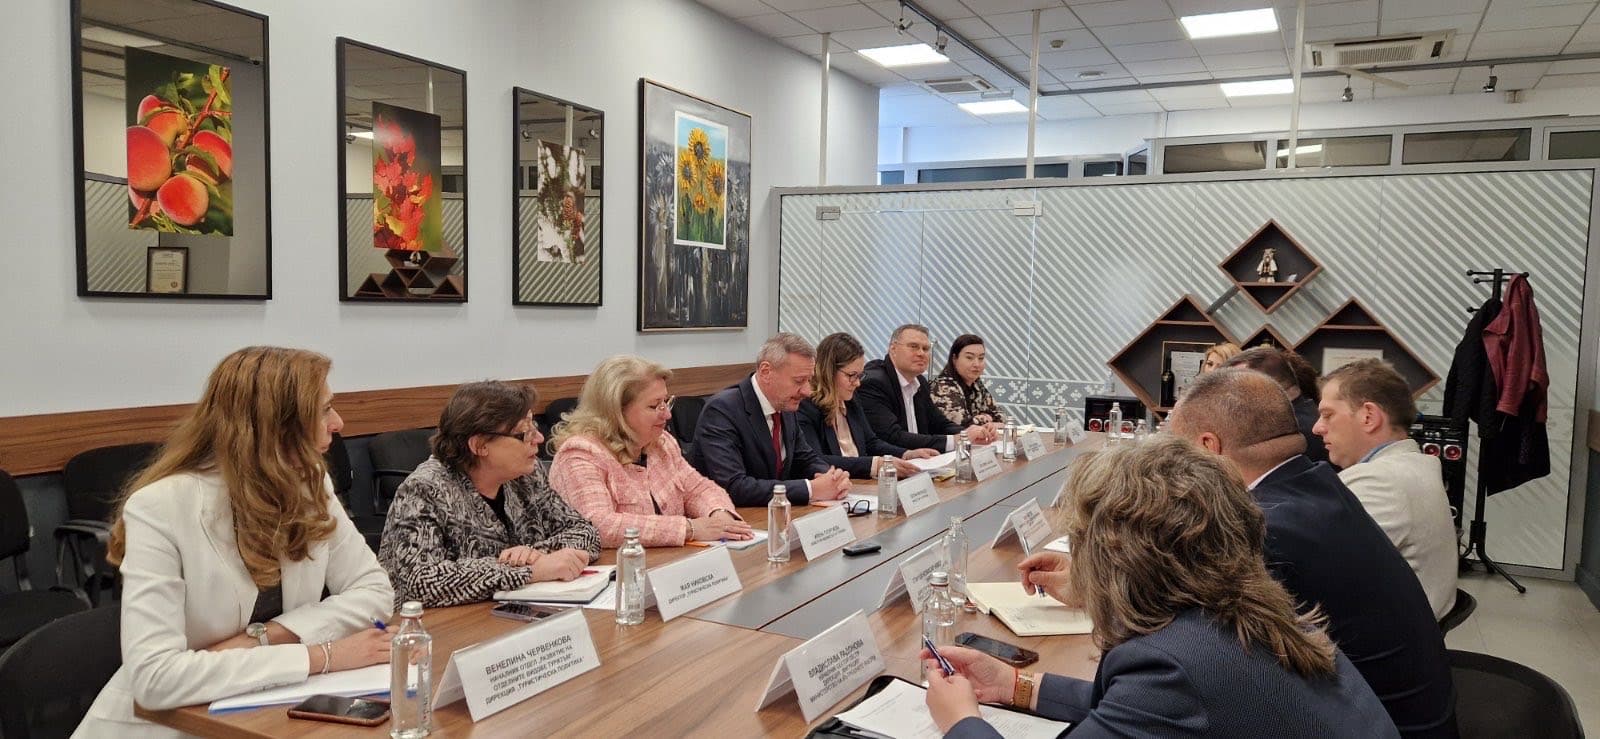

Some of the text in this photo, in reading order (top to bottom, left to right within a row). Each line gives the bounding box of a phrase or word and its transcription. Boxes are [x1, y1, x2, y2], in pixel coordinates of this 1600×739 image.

[485, 635, 572, 675] ВЕНЕЛИНА ЧЕРВЕНКОВА
[489, 667, 520, 682] НАЧАЛНИК
[520, 658, 537, 671] ОТДЕЛ
[565, 644, 573, 653] НА
[808, 653, 841, 679] ВЛАДИСЛАВА
[840, 638, 864, 658] РАДОНОВА
[485, 686, 516, 705] ДИРЕКЦИЯ
[493, 674, 525, 691] ОТДЕЛНИТЕ
[526, 666, 547, 678] ВИДОВЕ
